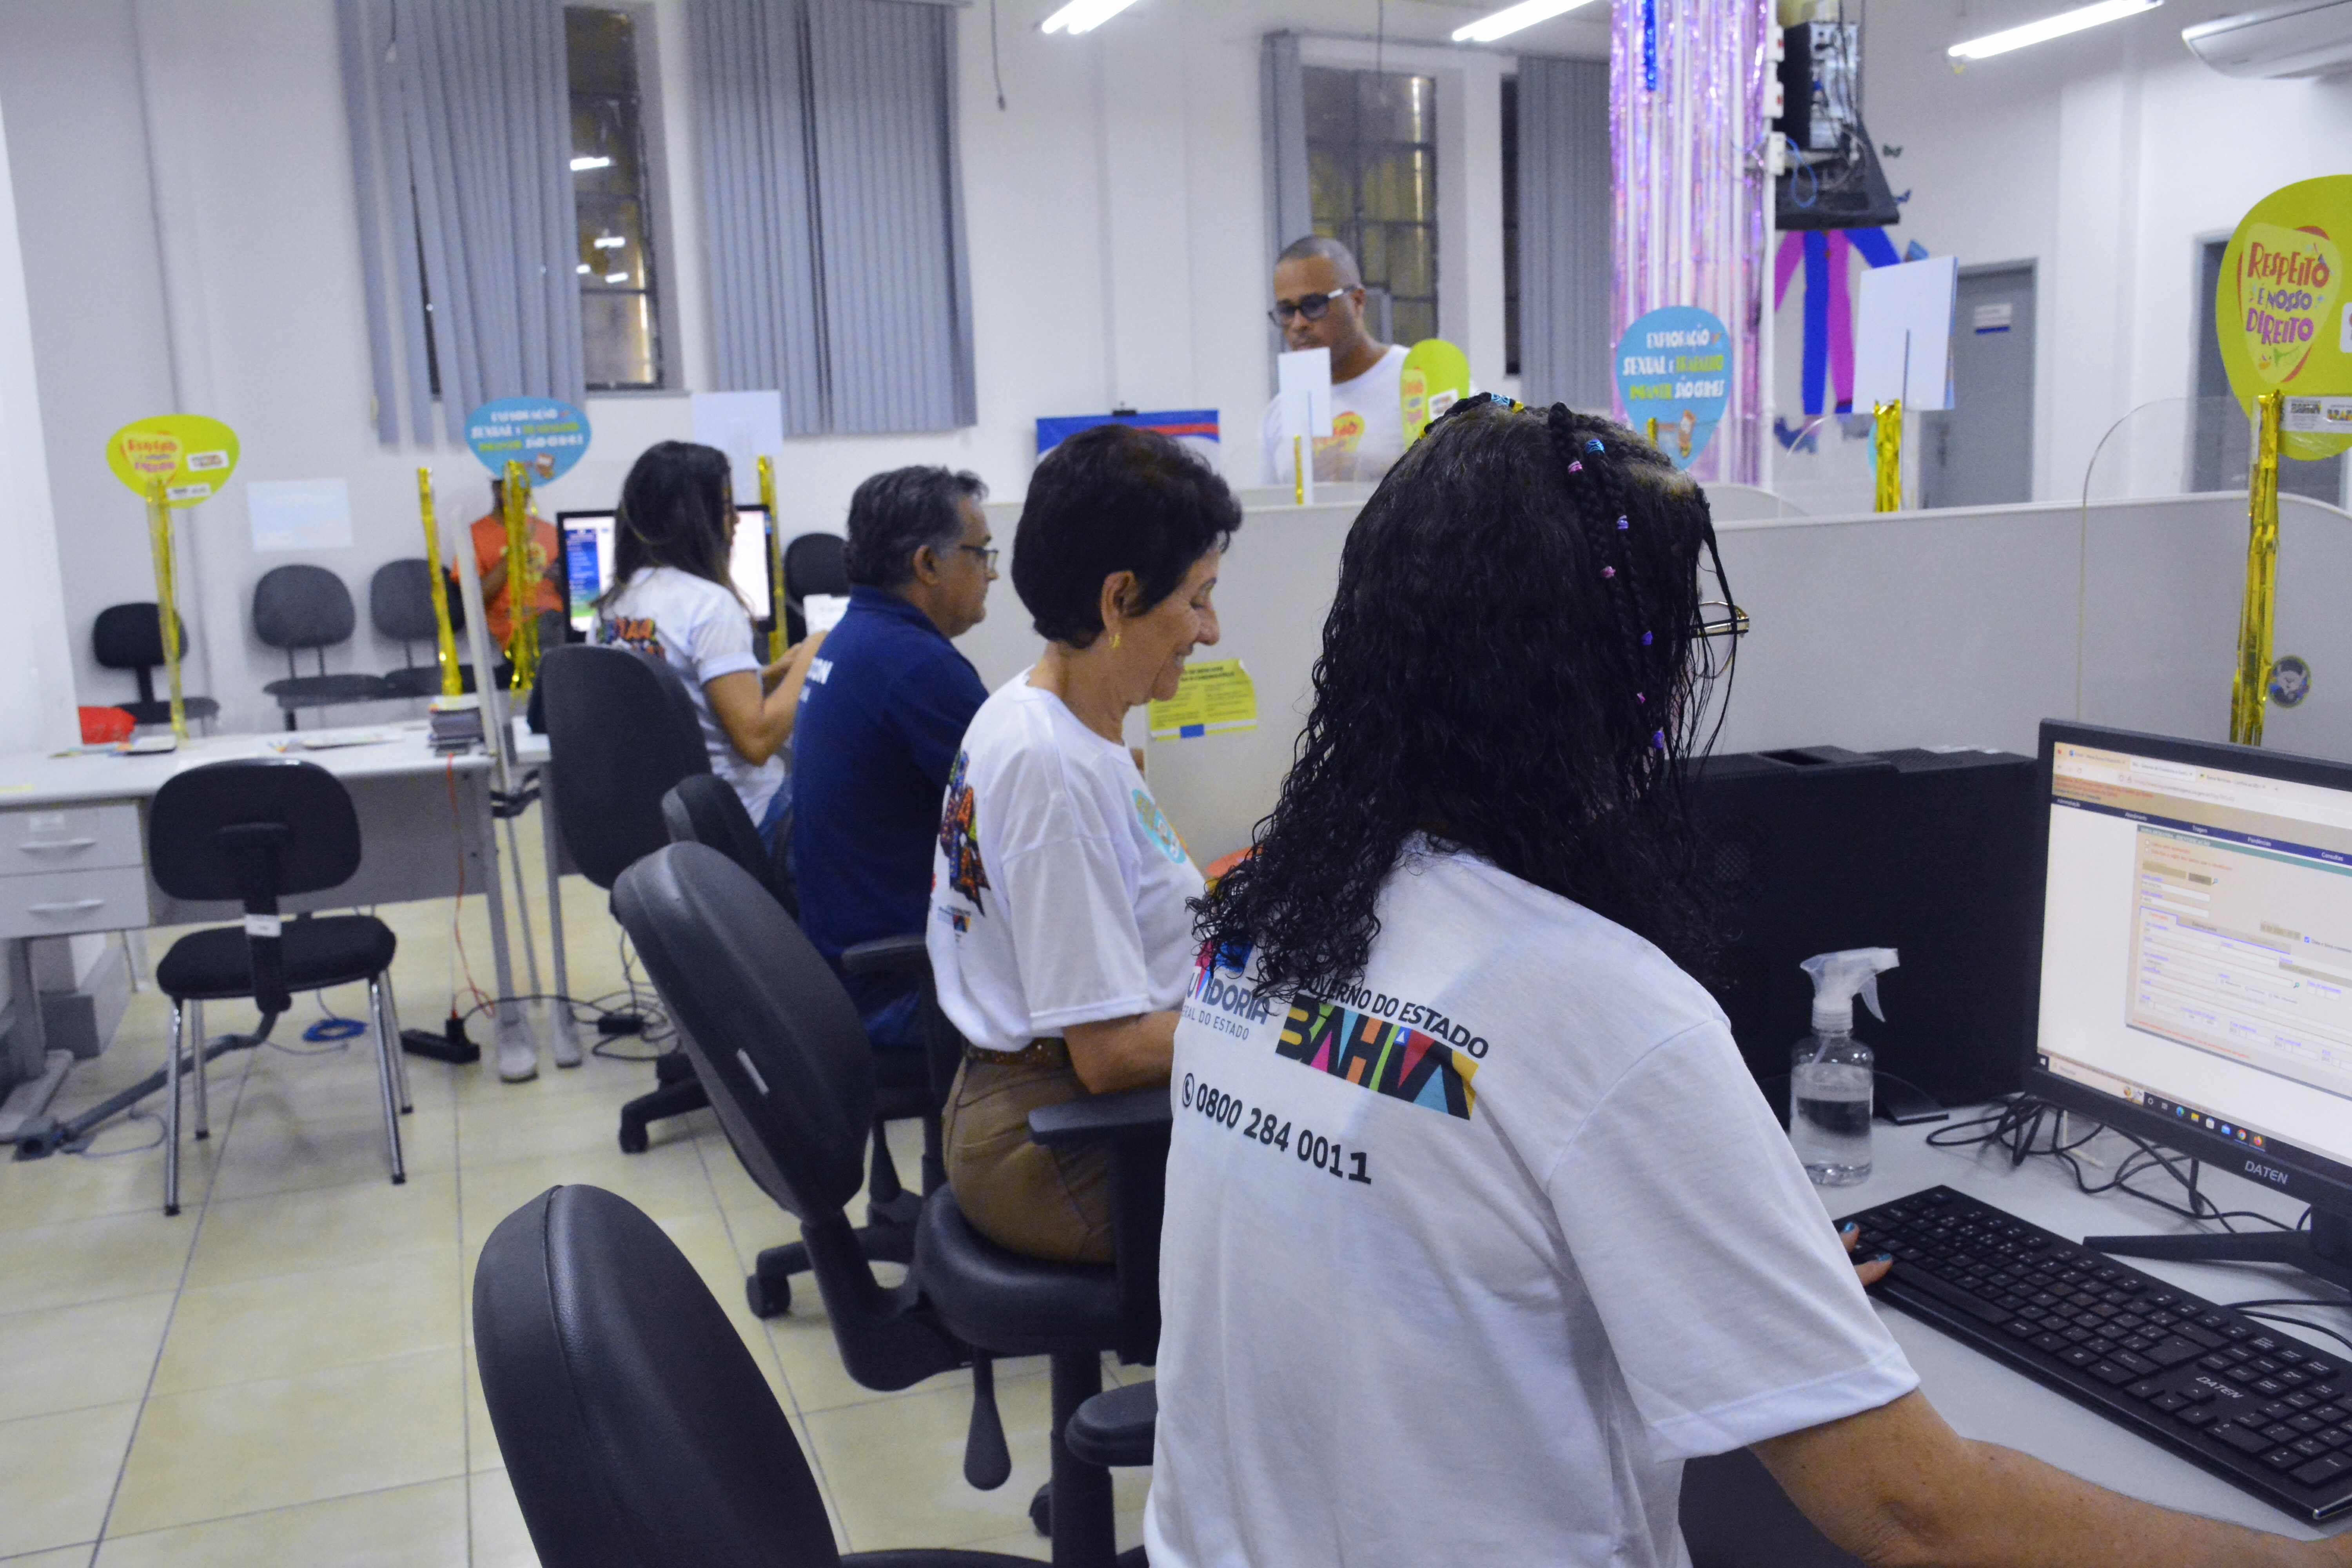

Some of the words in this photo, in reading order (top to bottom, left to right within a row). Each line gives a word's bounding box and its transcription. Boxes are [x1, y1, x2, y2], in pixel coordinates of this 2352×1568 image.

[2247, 241, 2330, 288] RESPEITO
[2266, 289, 2312, 312] NOSSO
[2246, 307, 2314, 346] DIREITO
[2321, 851, 2344, 862] Consultas
[1199, 1010, 1212, 1025] DO
[1213, 1016, 1249, 1040] ESTADO
[1372, 993, 1399, 1018] DO
[1399, 1002, 1489, 1059] ESTADO
[1275, 993, 1479, 1121] BAHIA
[1196, 1083, 1243, 1129] 0800
[1243, 1108, 1292, 1152] 284
[1297, 1129, 1372, 1185] 0011
[2245, 1160, 2288, 1185] DATEN
[2195, 1376, 2245, 1398] DATEN
